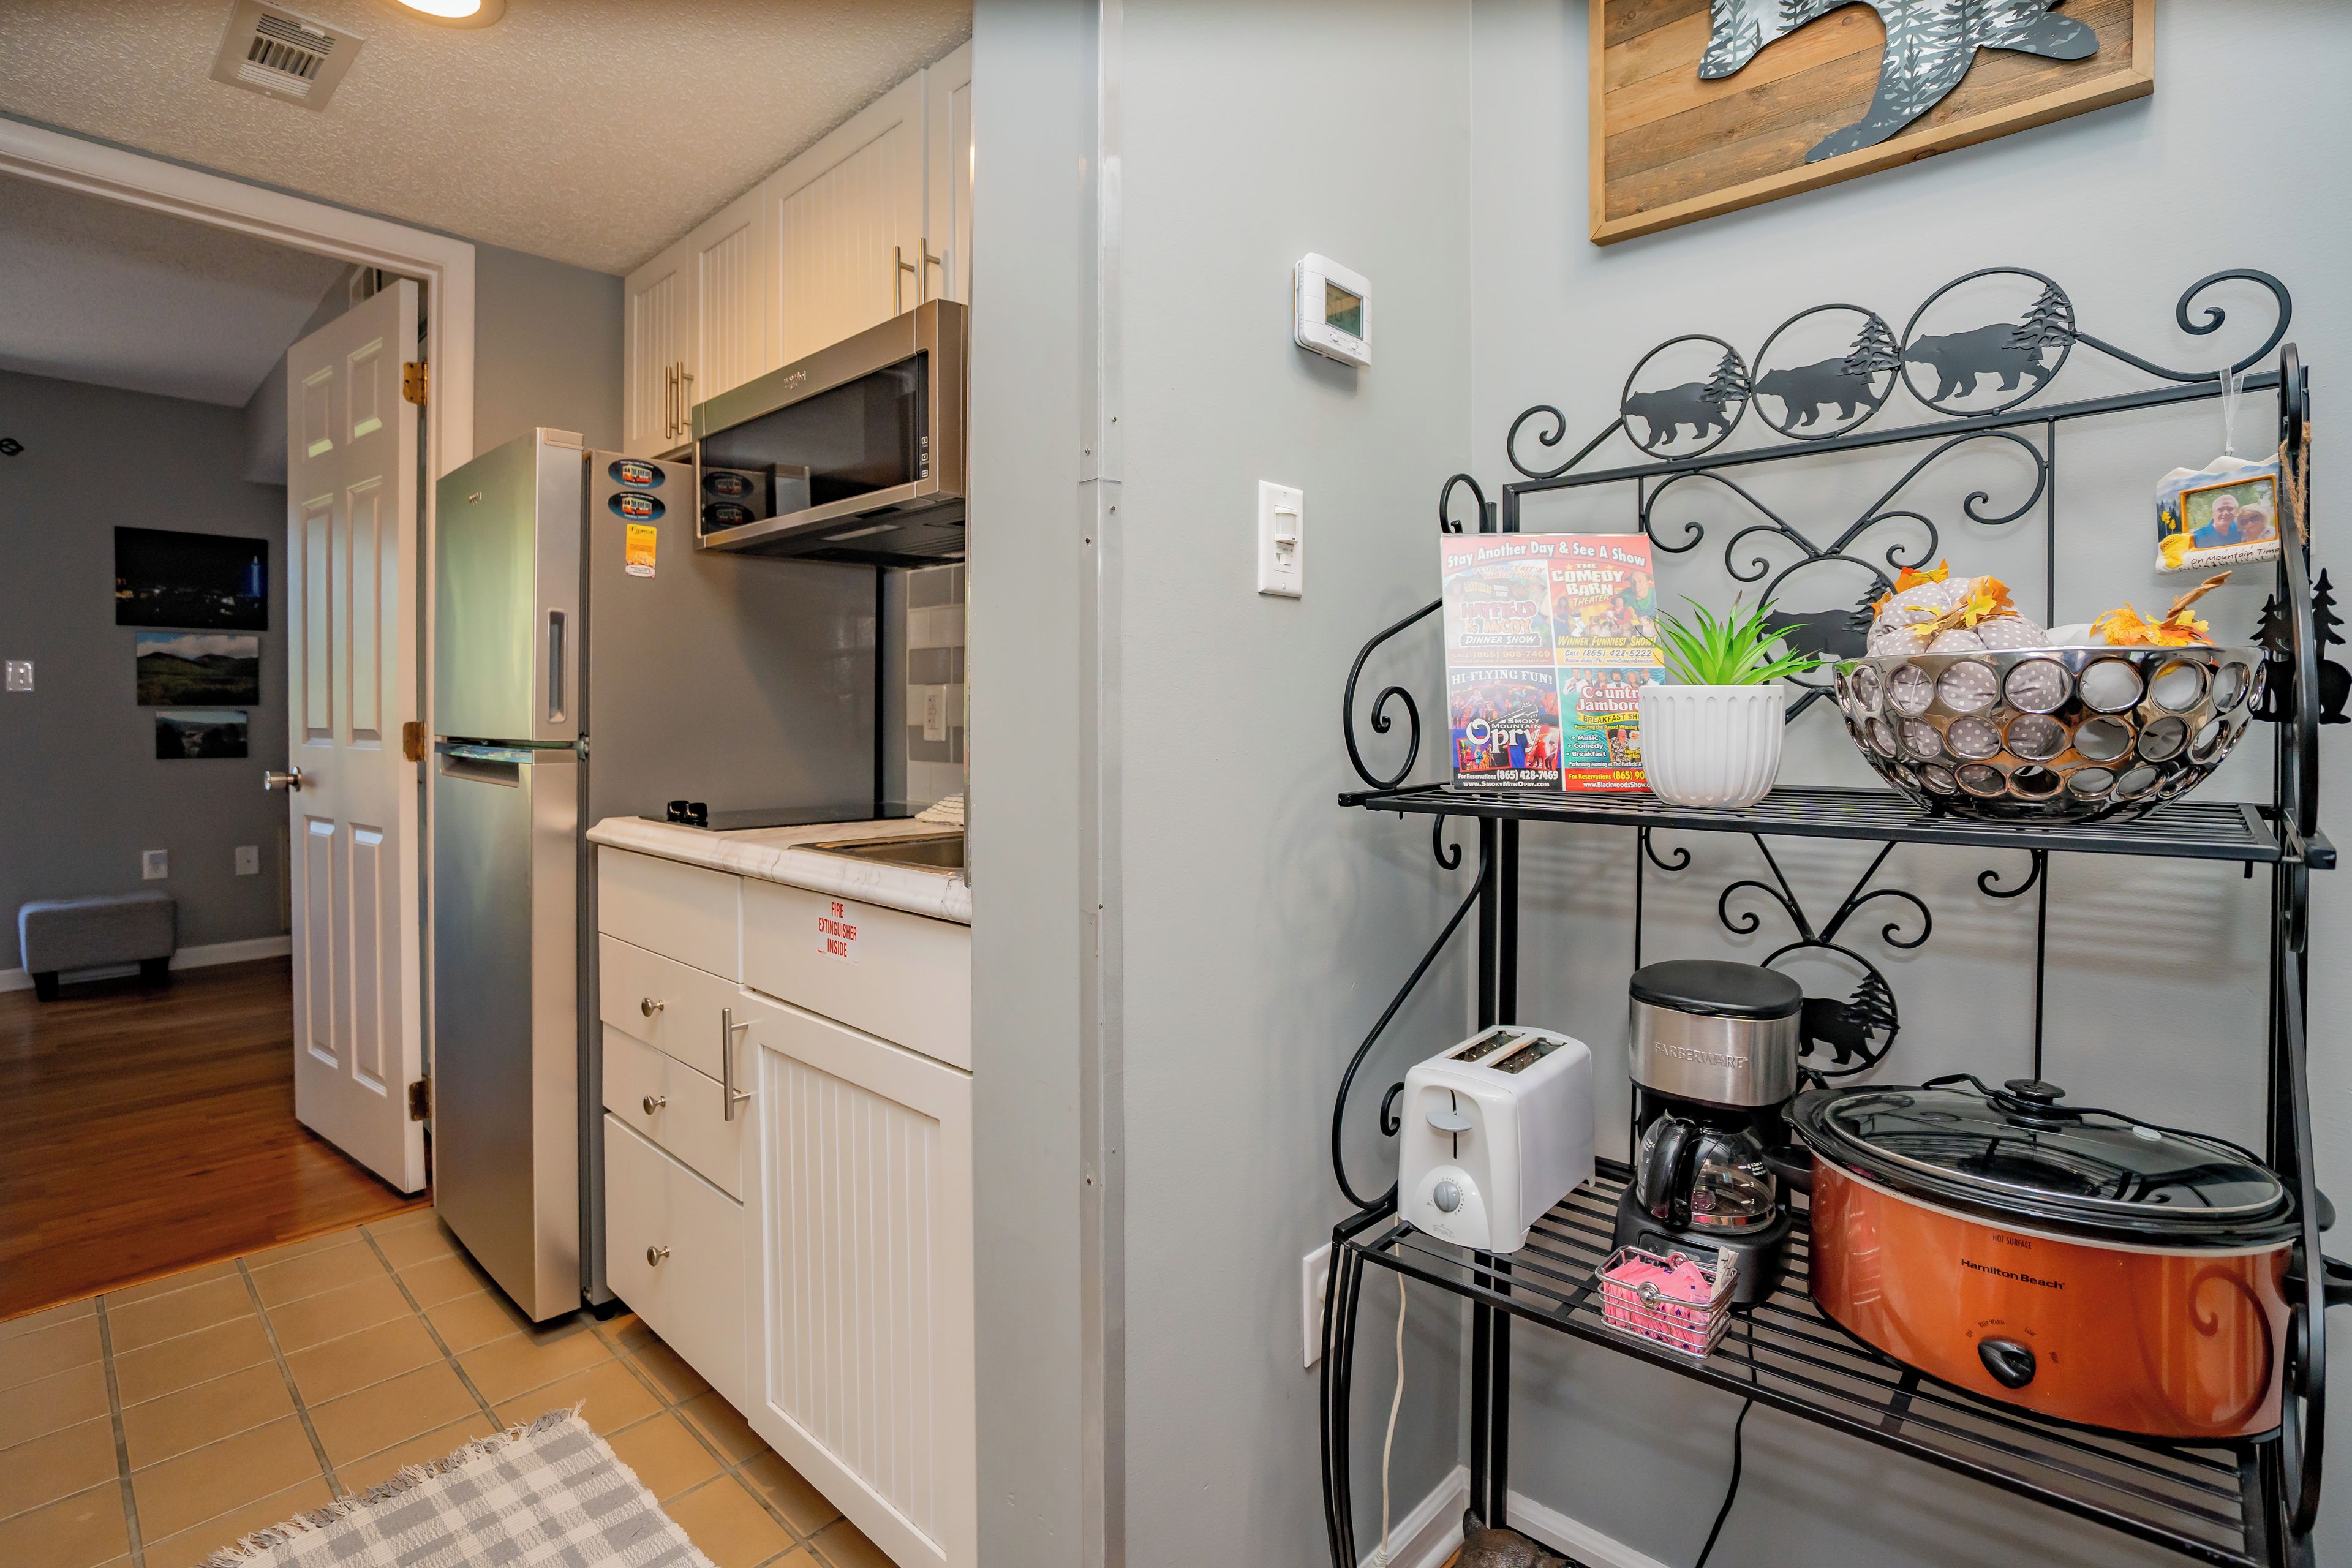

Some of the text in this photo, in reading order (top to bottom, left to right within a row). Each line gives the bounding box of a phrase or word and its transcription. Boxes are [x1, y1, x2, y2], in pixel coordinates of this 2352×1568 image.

[1448, 541, 1646, 568] Stay Another Day & See A Show
[2206, 551, 2253, 562] Mountain
[1551, 570, 1624, 582] COMEDY
[1566, 582, 1613, 597] BARN
[1573, 594, 1610, 607] THEATER
[1461, 601, 1537, 619] HATFIELD
[1466, 635, 1537, 644] DINNER SHOW
[1558, 635, 1657, 647] WINNER FUNNIEST SHOW!
[1451, 669, 1553, 685] HI-FLYING FUN!
[1583, 714, 1625, 723] BREAKFAST
[1466, 718, 1541, 753] Opry
[1496, 770, 1518, 781] (865)
[1519, 771, 1559, 780] 428-7469
[1613, 771, 1633, 780] (865)
[831, 902, 843, 919] FIRE
[818, 917, 857, 941] EXTINGUISHER
[827, 938, 847, 957] INSIDE
[1654, 1041, 1744, 1069] FARBERWARE
[1992, 1234, 2032, 1250] HOT SURFACE
[1961, 1258, 2063, 1290] Hamilton Beach
